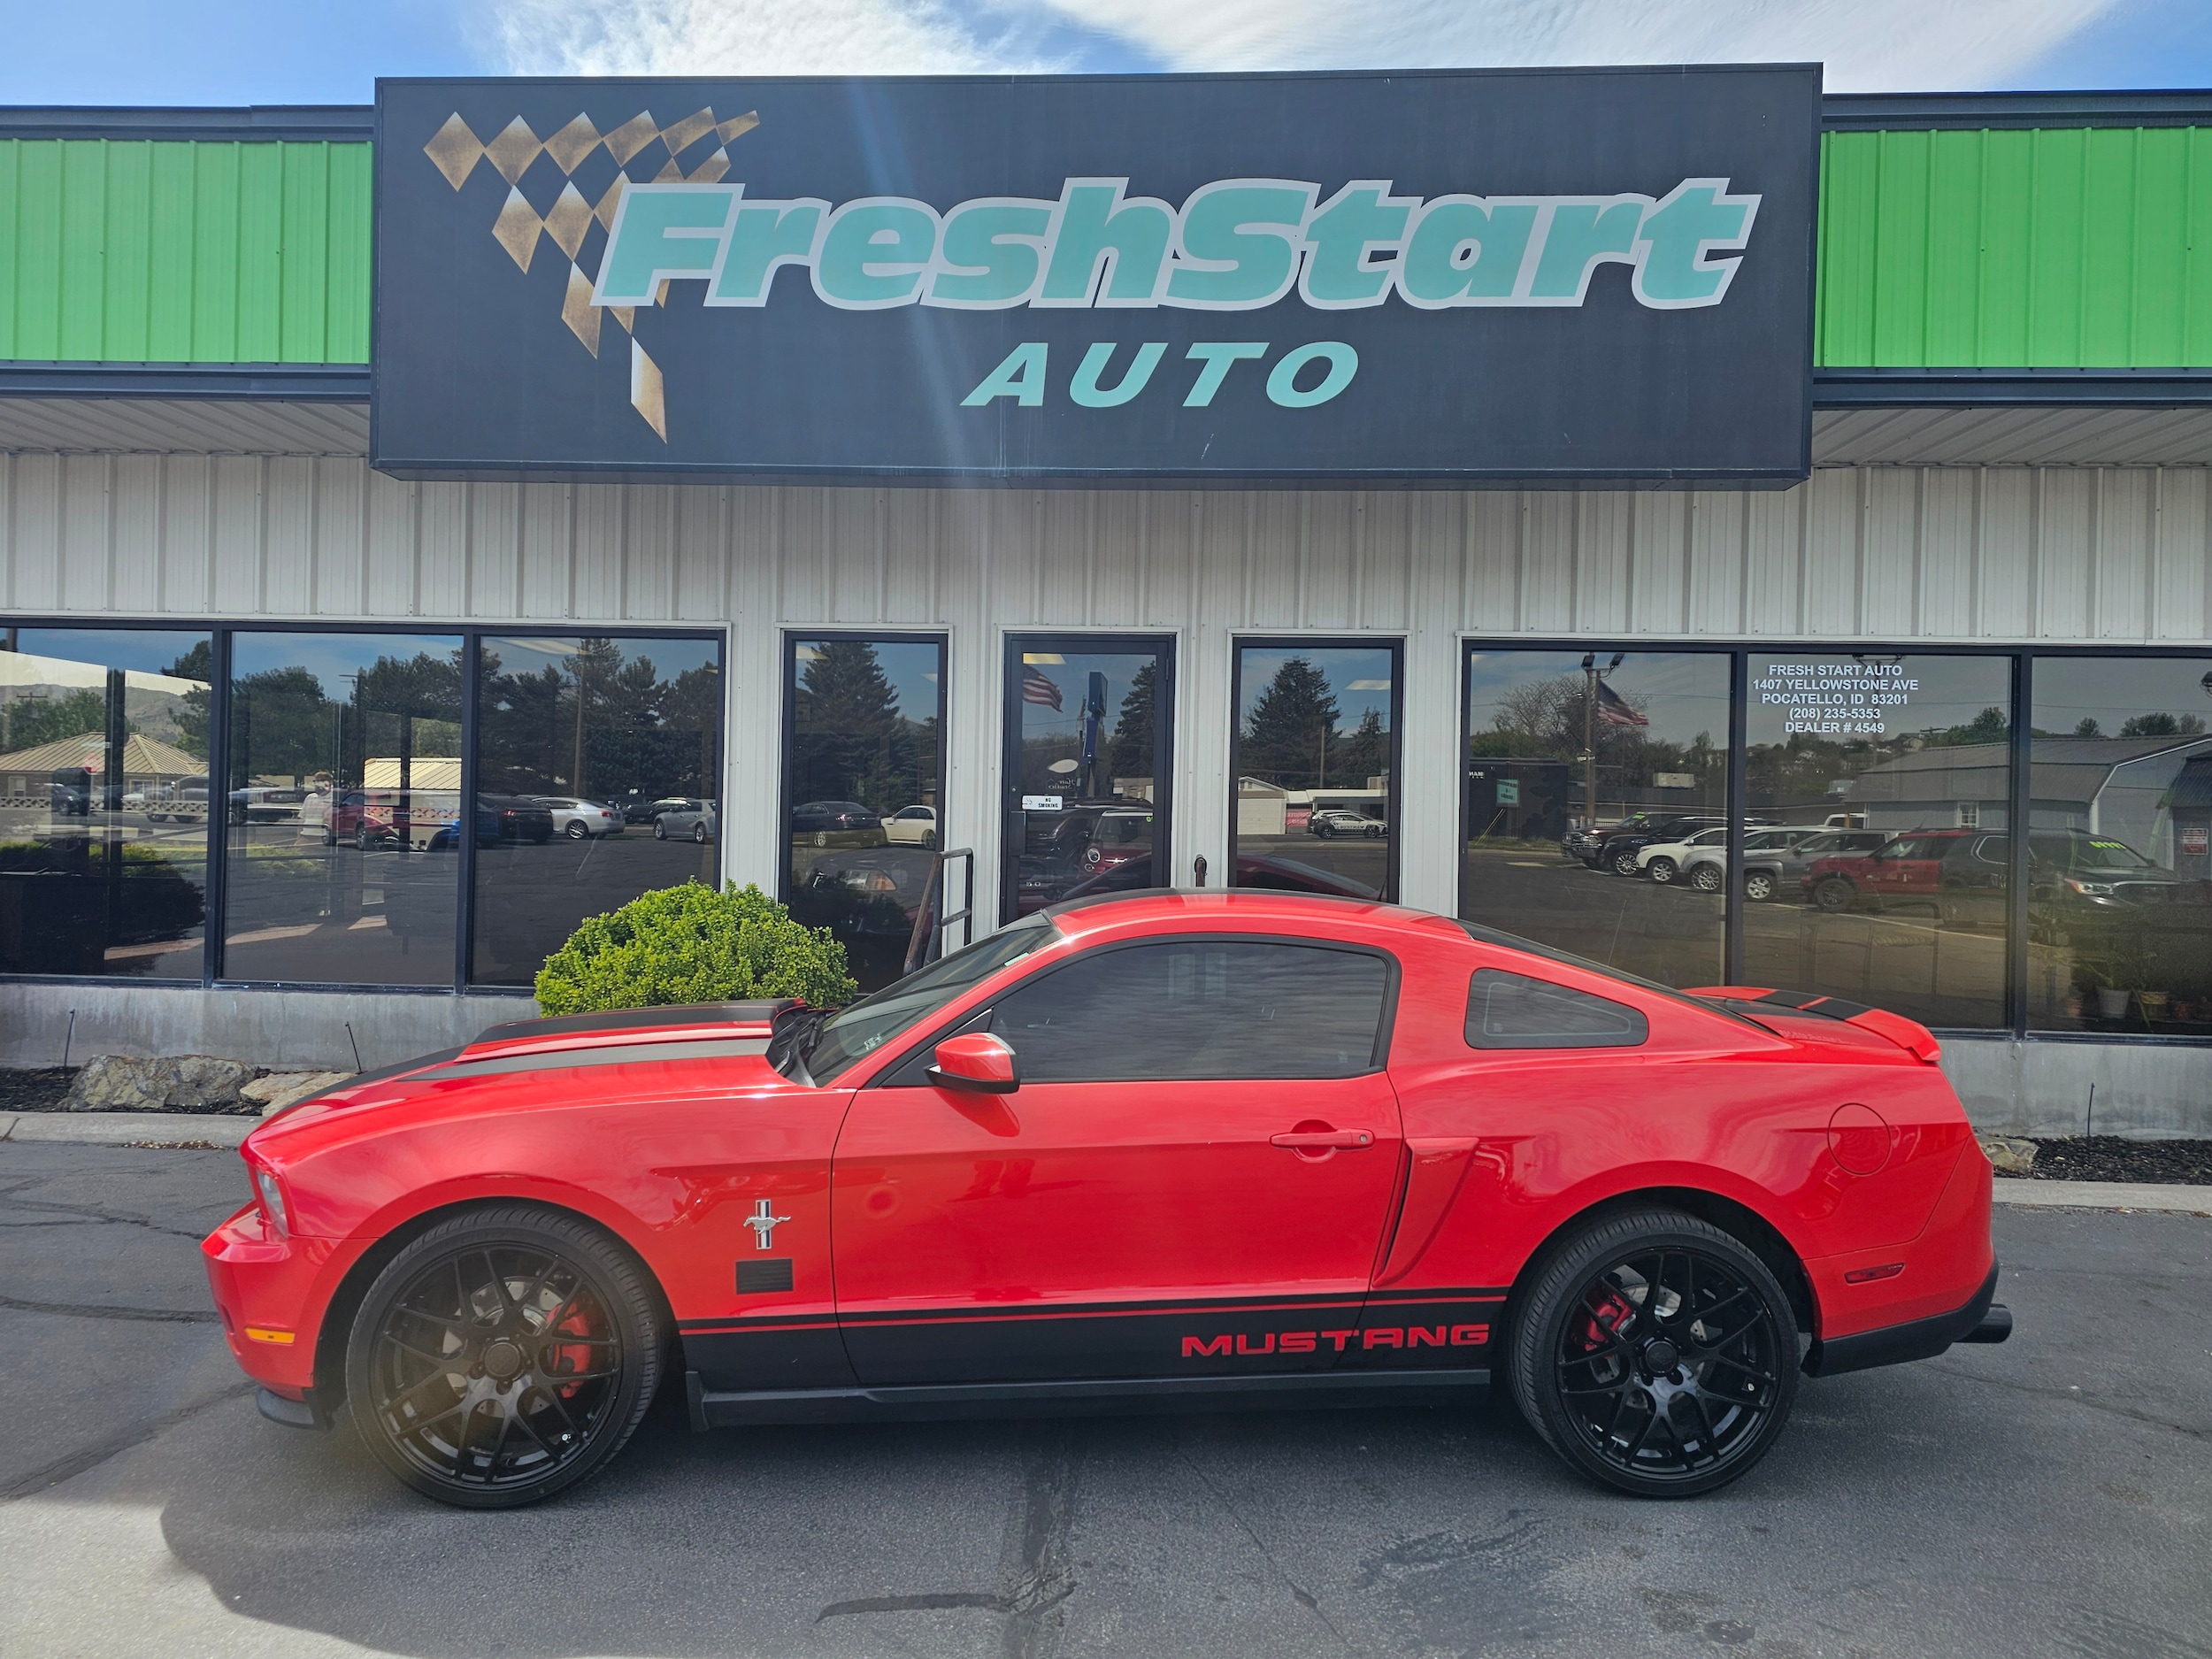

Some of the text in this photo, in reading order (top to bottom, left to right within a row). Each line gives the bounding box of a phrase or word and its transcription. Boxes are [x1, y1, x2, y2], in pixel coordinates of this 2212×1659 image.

[589, 177, 1762, 311] FreshStart
[959, 341, 1358, 408] AUTO
[1769, 664, 1902, 676] FRESH START AUTO
[1753, 680, 1918, 690] 1407 YELLOWSTONE AVE
[1762, 694, 1908, 705] POCATELLO, ID 83201
[1789, 709, 1881, 720] (208) 235-5353
[1786, 722, 1885, 733] DEALER # 4549
[1181, 1324, 1490, 1357] MUSTANG
